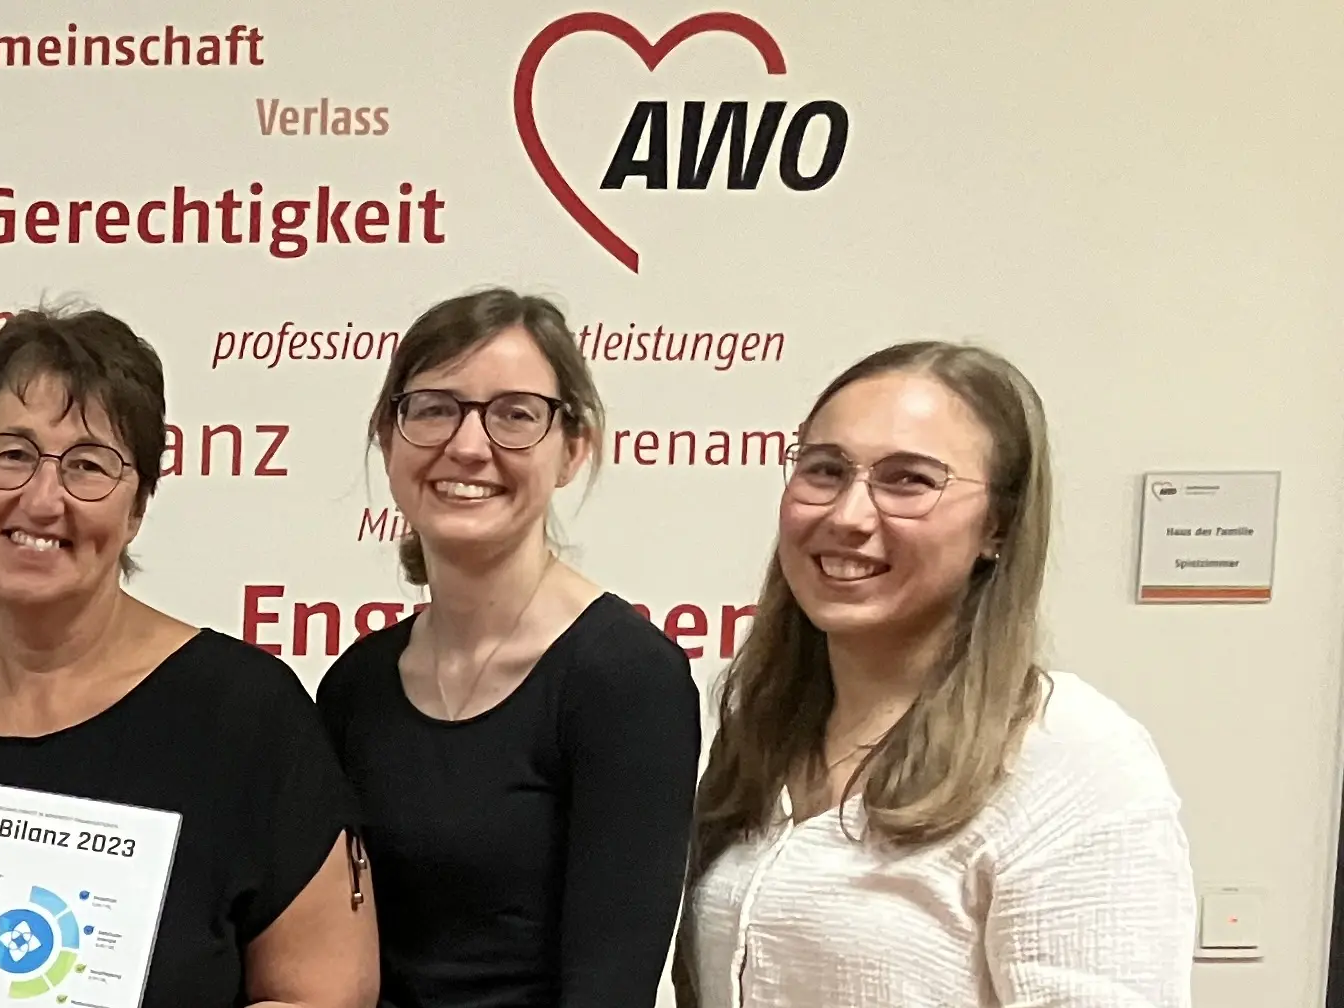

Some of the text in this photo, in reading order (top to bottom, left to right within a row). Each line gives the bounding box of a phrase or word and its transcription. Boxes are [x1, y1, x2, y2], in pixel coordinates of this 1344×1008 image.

[255, 97, 390, 136] Verlass
[599, 99, 849, 192] AWO
[76, 831, 136, 858] 2023
